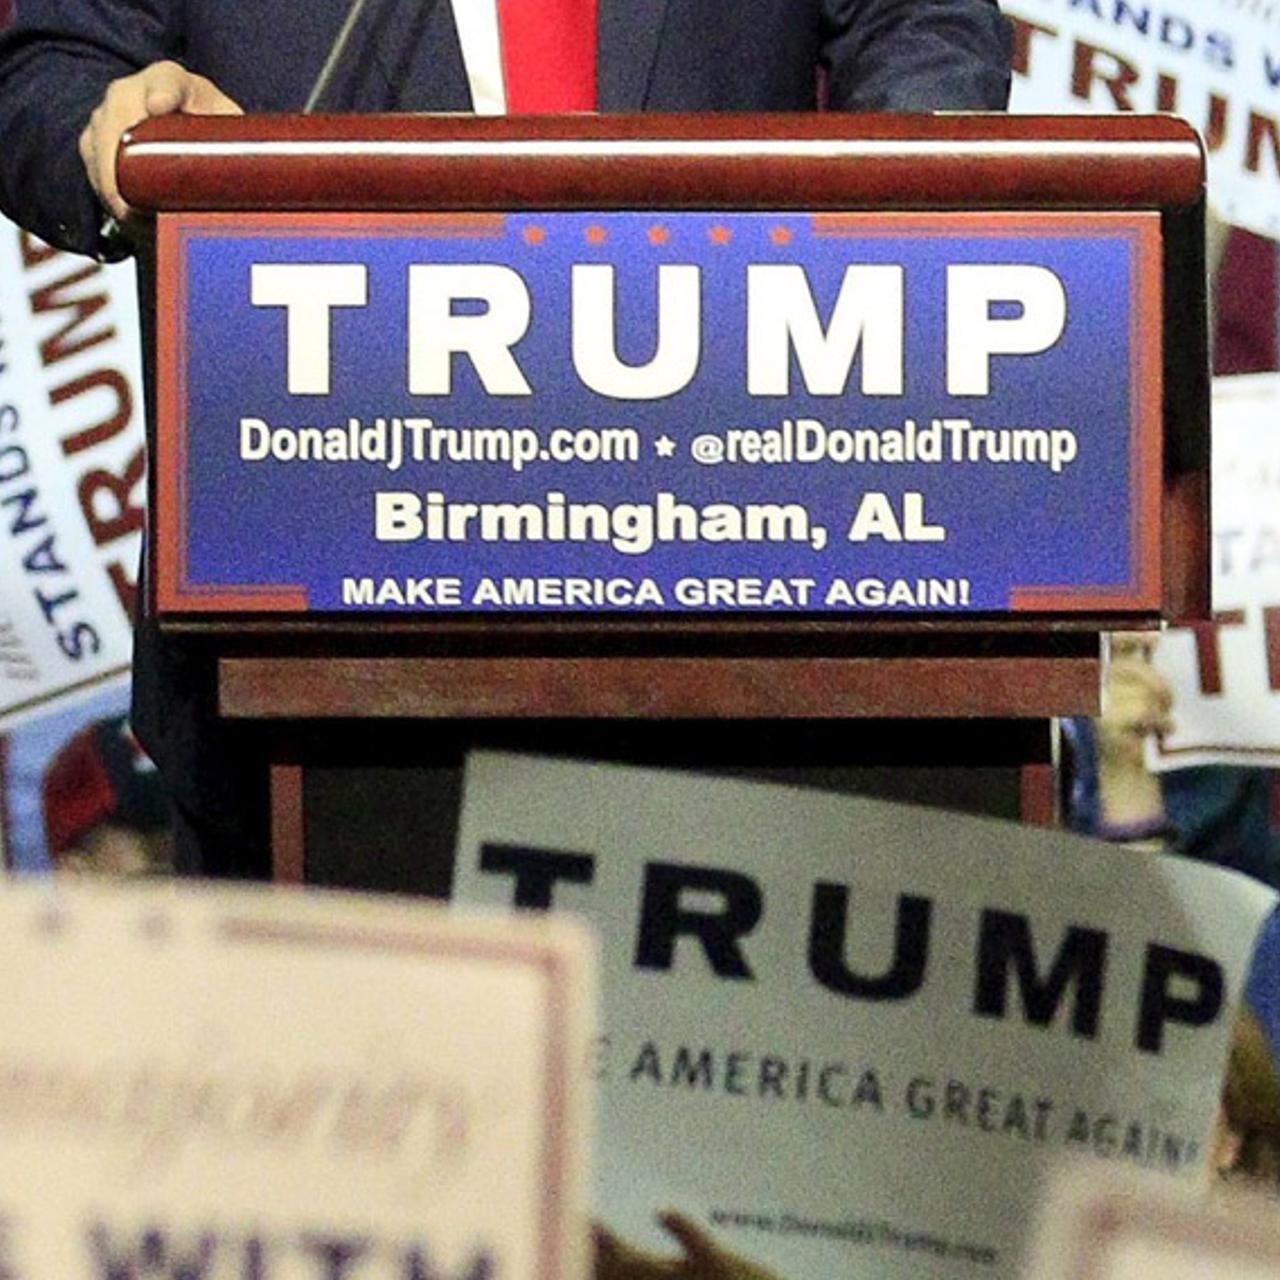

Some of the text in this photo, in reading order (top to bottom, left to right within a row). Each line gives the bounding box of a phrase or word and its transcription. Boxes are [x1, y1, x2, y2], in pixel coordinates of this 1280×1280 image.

[250, 262, 1067, 400] TRUMP
[238, 417, 1079, 472] DonaldJTrump.com @realDonaldTrump
[374, 491, 946, 554] Birmingham, AL
[341, 577, 970, 607] MAKE AMERICA GREAT AGAIN!
[477, 840, 1228, 1056] TRUMP
[629, 1038, 887, 1116] AMERICA
[905, 1075, 1058, 1144] GREAT
